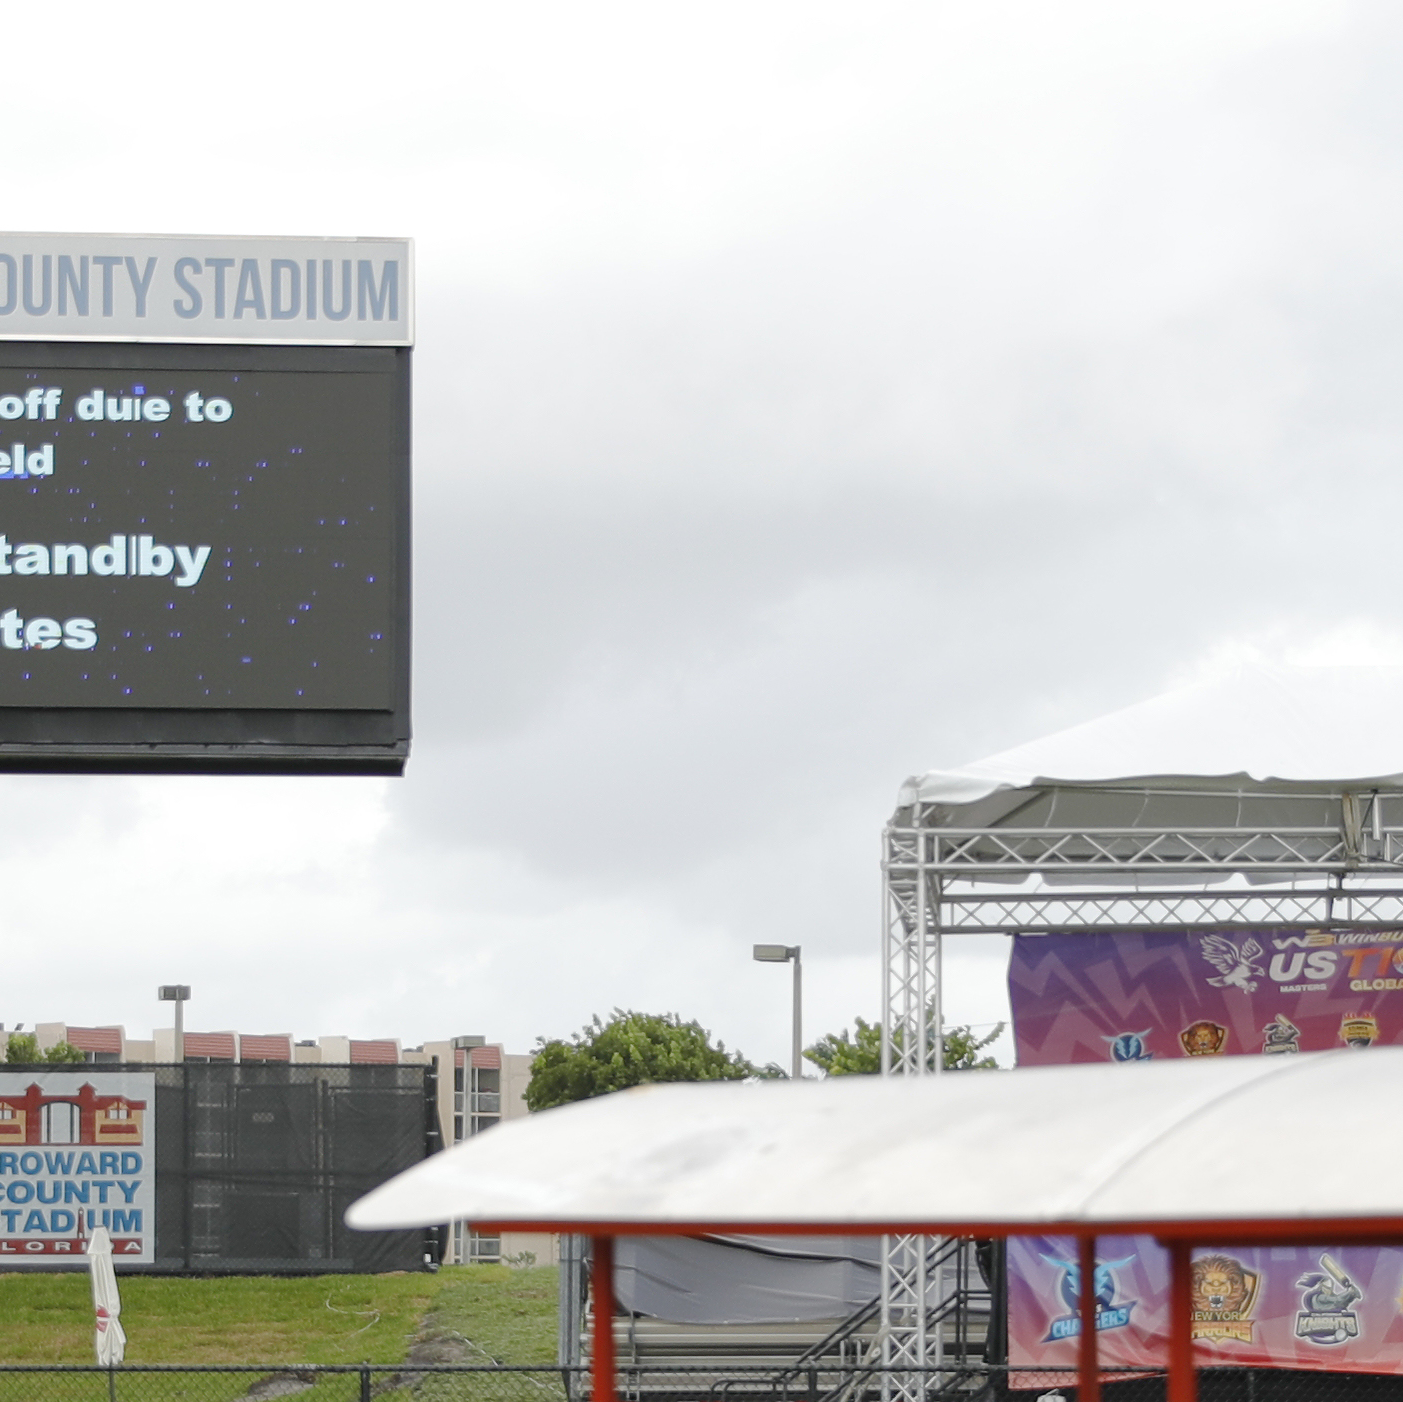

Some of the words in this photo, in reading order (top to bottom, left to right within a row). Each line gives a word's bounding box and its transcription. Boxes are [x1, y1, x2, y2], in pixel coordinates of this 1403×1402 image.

[173, 256, 399, 322] STADIUM
[185, 391, 233, 423] to
[1269, 950, 1339, 982] US
[1280, 983, 1328, 993] MASTERS
